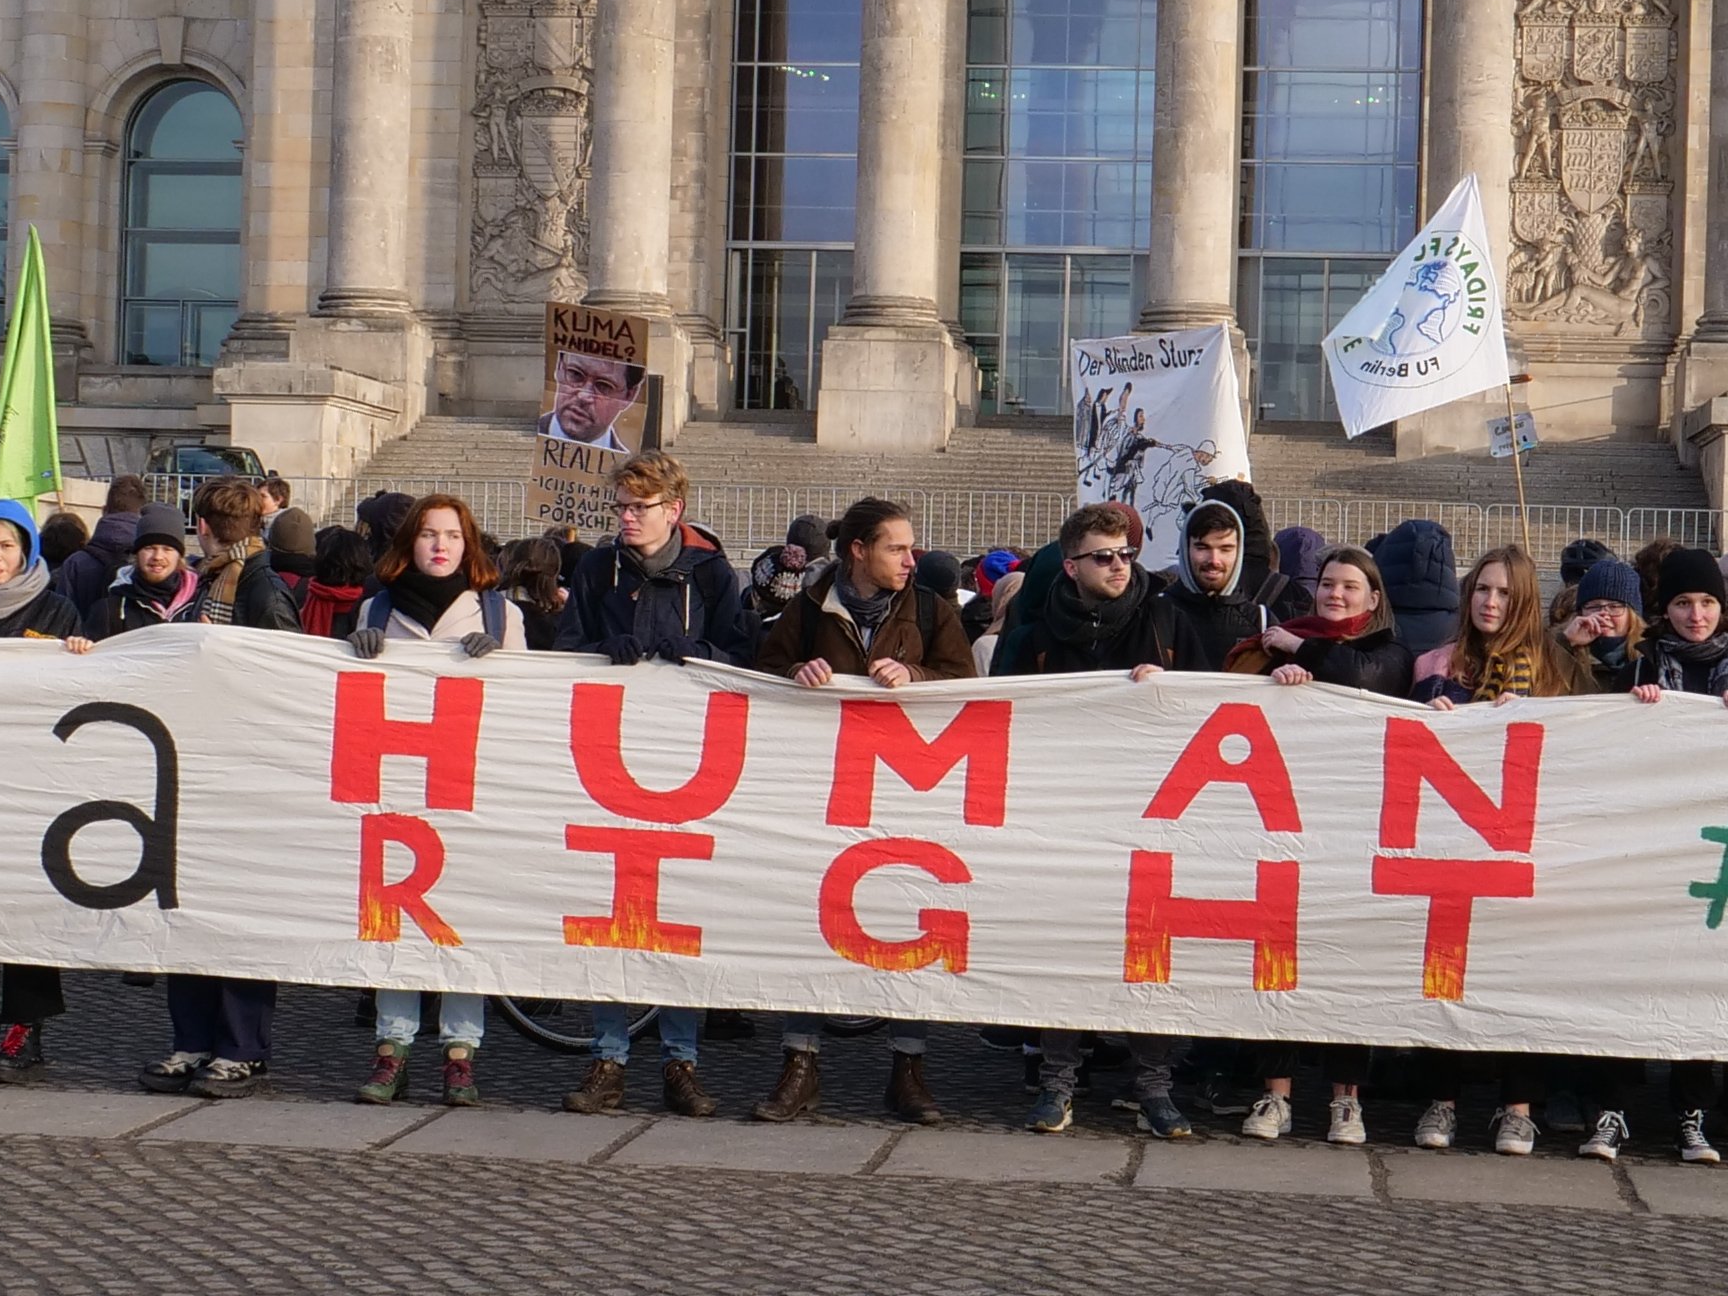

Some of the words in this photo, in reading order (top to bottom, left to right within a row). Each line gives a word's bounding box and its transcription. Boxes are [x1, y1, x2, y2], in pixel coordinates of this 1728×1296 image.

[553, 332, 636, 362] HANDEL?
[1078, 350, 1104, 376] Der
[1104, 344, 1155, 375] Blinden
[1158, 338, 1204, 368] Sturz
[539, 504, 616, 533] PORSCHE
[555, 493, 576, 510] SO
[577, 499, 611, 513] AUF
[330, 670, 1545, 854] HUMAN
[40, 700, 180, 911] a
[357, 811, 1535, 1001] RIGHT
